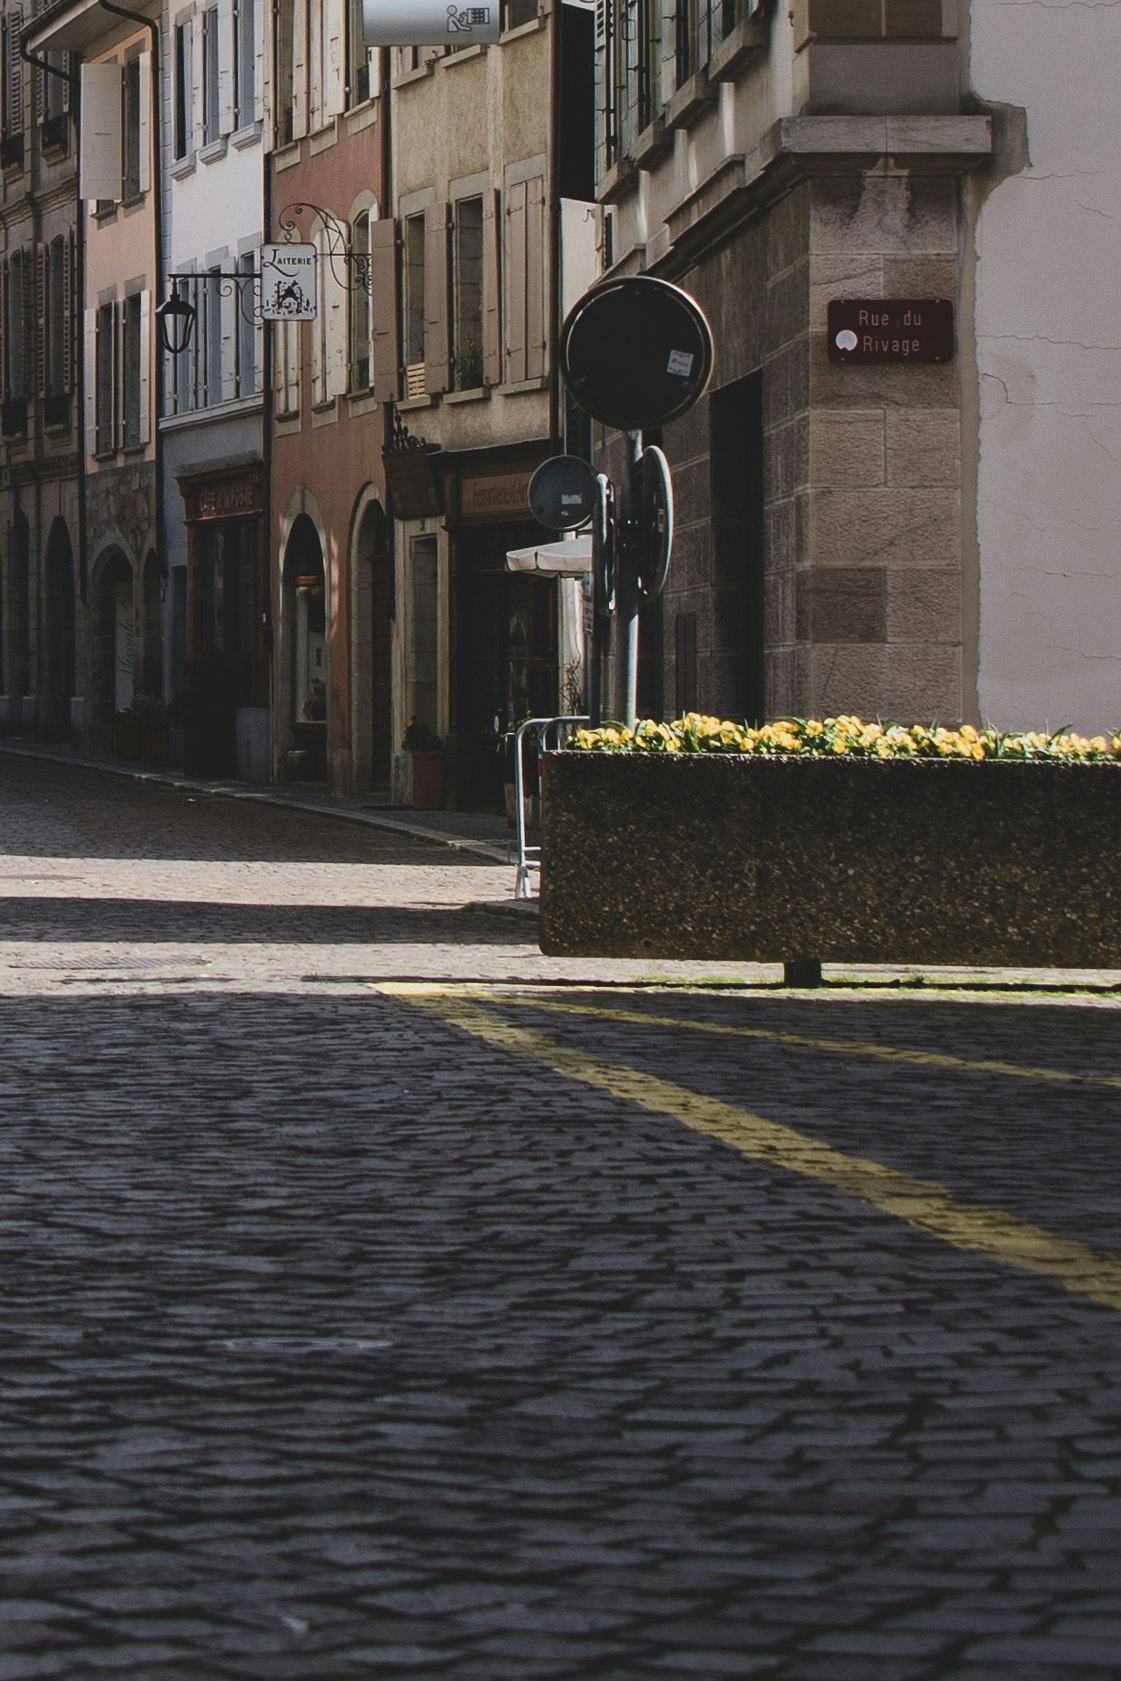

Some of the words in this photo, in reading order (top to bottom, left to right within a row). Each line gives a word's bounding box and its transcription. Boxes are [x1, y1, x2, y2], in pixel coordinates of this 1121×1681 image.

[263, 249, 312, 277] LAITERIE
[859, 309, 890, 327] Rue
[903, 309, 922, 327] du
[863, 335, 921, 356] Rivage
